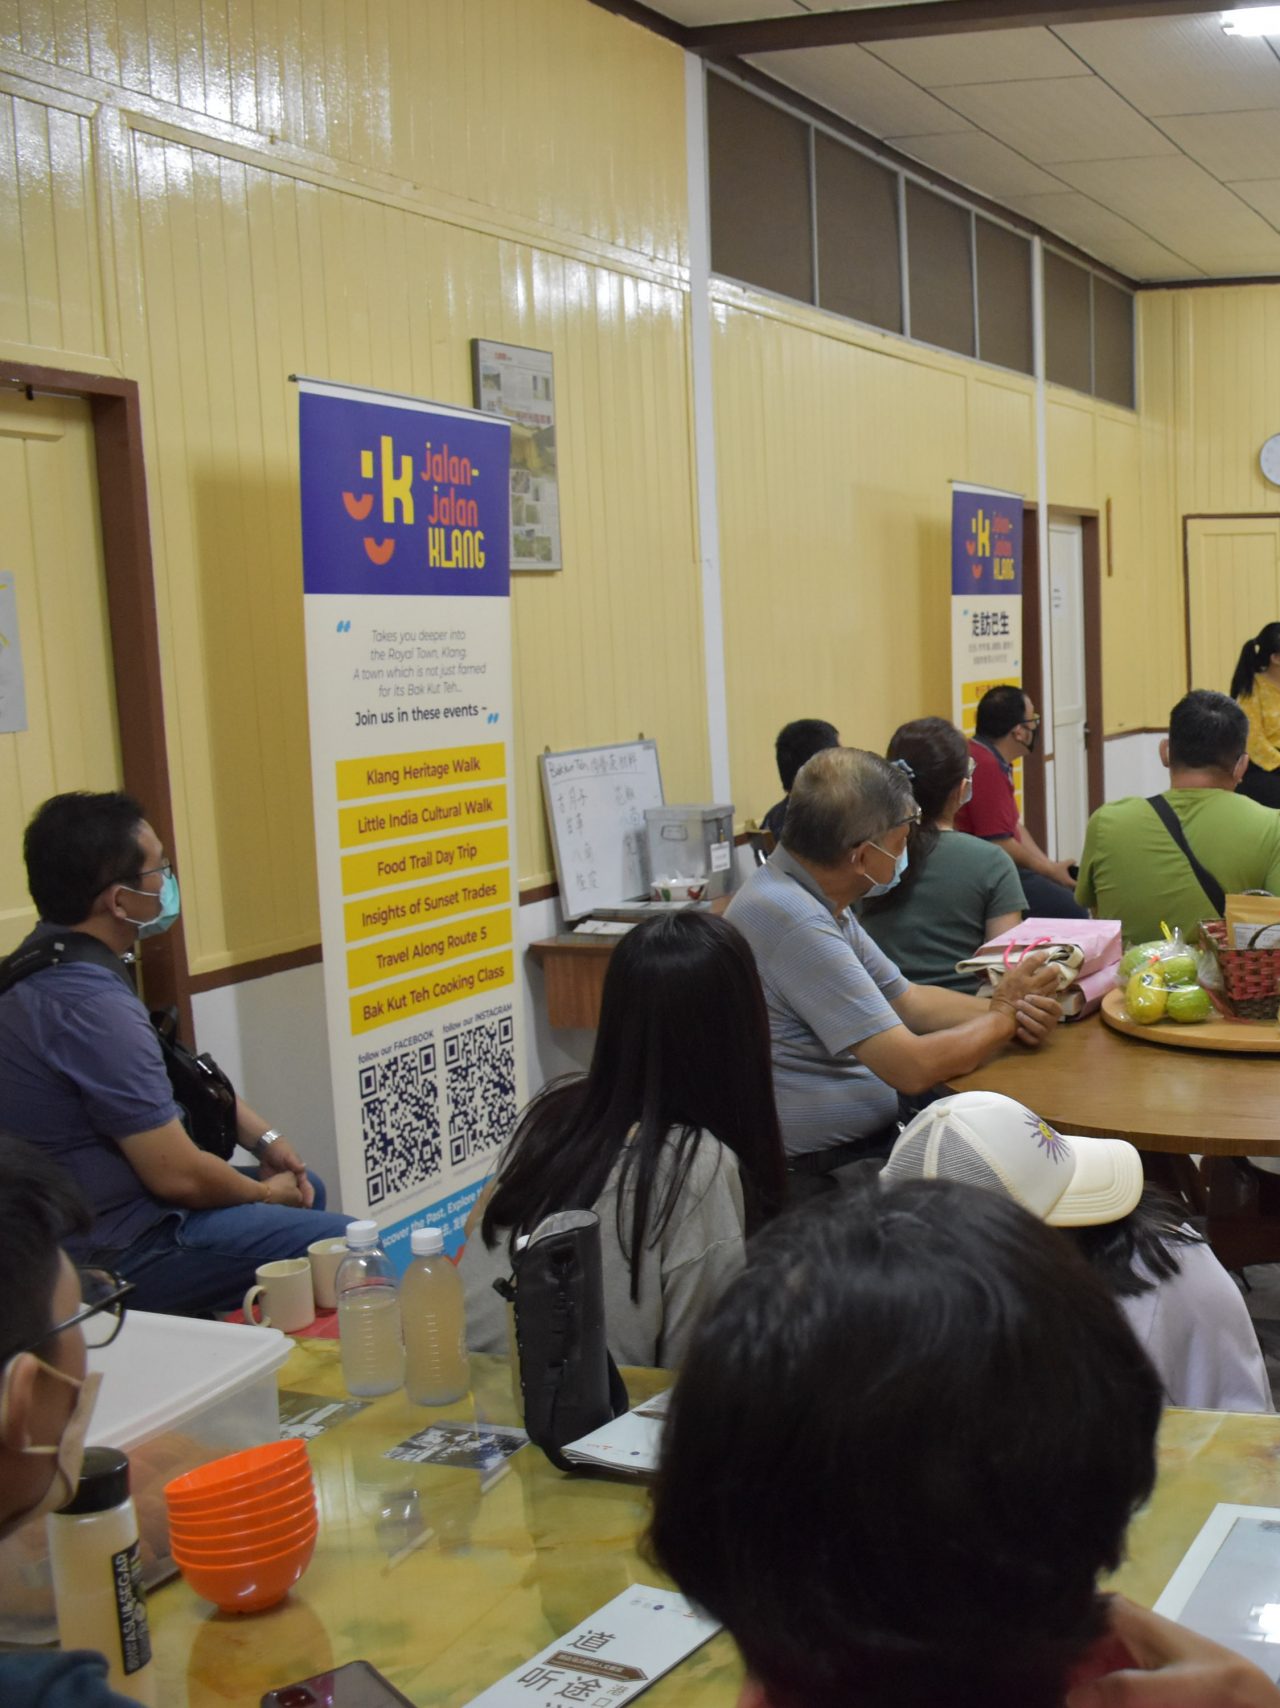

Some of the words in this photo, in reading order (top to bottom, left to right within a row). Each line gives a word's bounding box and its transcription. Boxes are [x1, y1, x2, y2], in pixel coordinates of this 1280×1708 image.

[421, 441, 479, 486] jalan-
[428, 485, 478, 528] jalan
[428, 527, 485, 569] KLANG
[372, 629, 398, 643] Takes
[400, 631, 416, 645] you
[418, 629, 448, 644] deeper
[353, 668, 360, 680] A
[362, 668, 385, 680] town
[386, 666, 415, 679] which
[416, 665, 424, 677] is
[425, 665, 438, 677] not
[439, 664, 456, 679] just
[457, 663, 487, 676] famed
[370, 648, 386, 662] the
[388, 647, 414, 663] Royal
[378, 685, 391, 698] for
[407, 683, 425, 696] Bak
[426, 682, 441, 695] Kut
[355, 708, 378, 727] Join
[381, 711, 394, 724] us
[397, 707, 409, 723] in
[411, 706, 441, 721] these
[443, 702, 480, 719] events
[366, 768, 400, 786] Klang
[403, 762, 450, 780] Heritage
[452, 756, 481, 773] Walk
[358, 815, 386, 834] Little
[389, 809, 419, 828] India
[421, 803, 462, 822] Cultural
[465, 797, 494, 815] Walk
[377, 857, 407, 877] Food
[409, 851, 433, 870] Trail
[435, 849, 455, 866] Day
[457, 843, 478, 860] Trip
[361, 905, 406, 928] Insights
[409, 900, 421, 915] of
[424, 892, 460, 912] Sunset
[462, 883, 497, 902] Trades
[376, 946, 410, 970] Travel
[412, 940, 445, 959] Along
[447, 930, 478, 950] Route
[480, 926, 488, 940] 5
[362, 1004, 385, 1022] Bak
[387, 994, 408, 1013] Kut
[409, 986, 430, 1005] Teh
[432, 974, 475, 998] Cooking
[477, 965, 505, 983] Class
[442, 1021, 462, 1034] follow
[474, 1003, 513, 1022] INSTAGRAM
[358, 1050, 380, 1064] follow
[381, 1045, 393, 1056] our
[393, 1029, 435, 1050] FACEBOOK
[567, 1629, 617, 1653] 道
[516, 1667, 603, 1702] 听途
